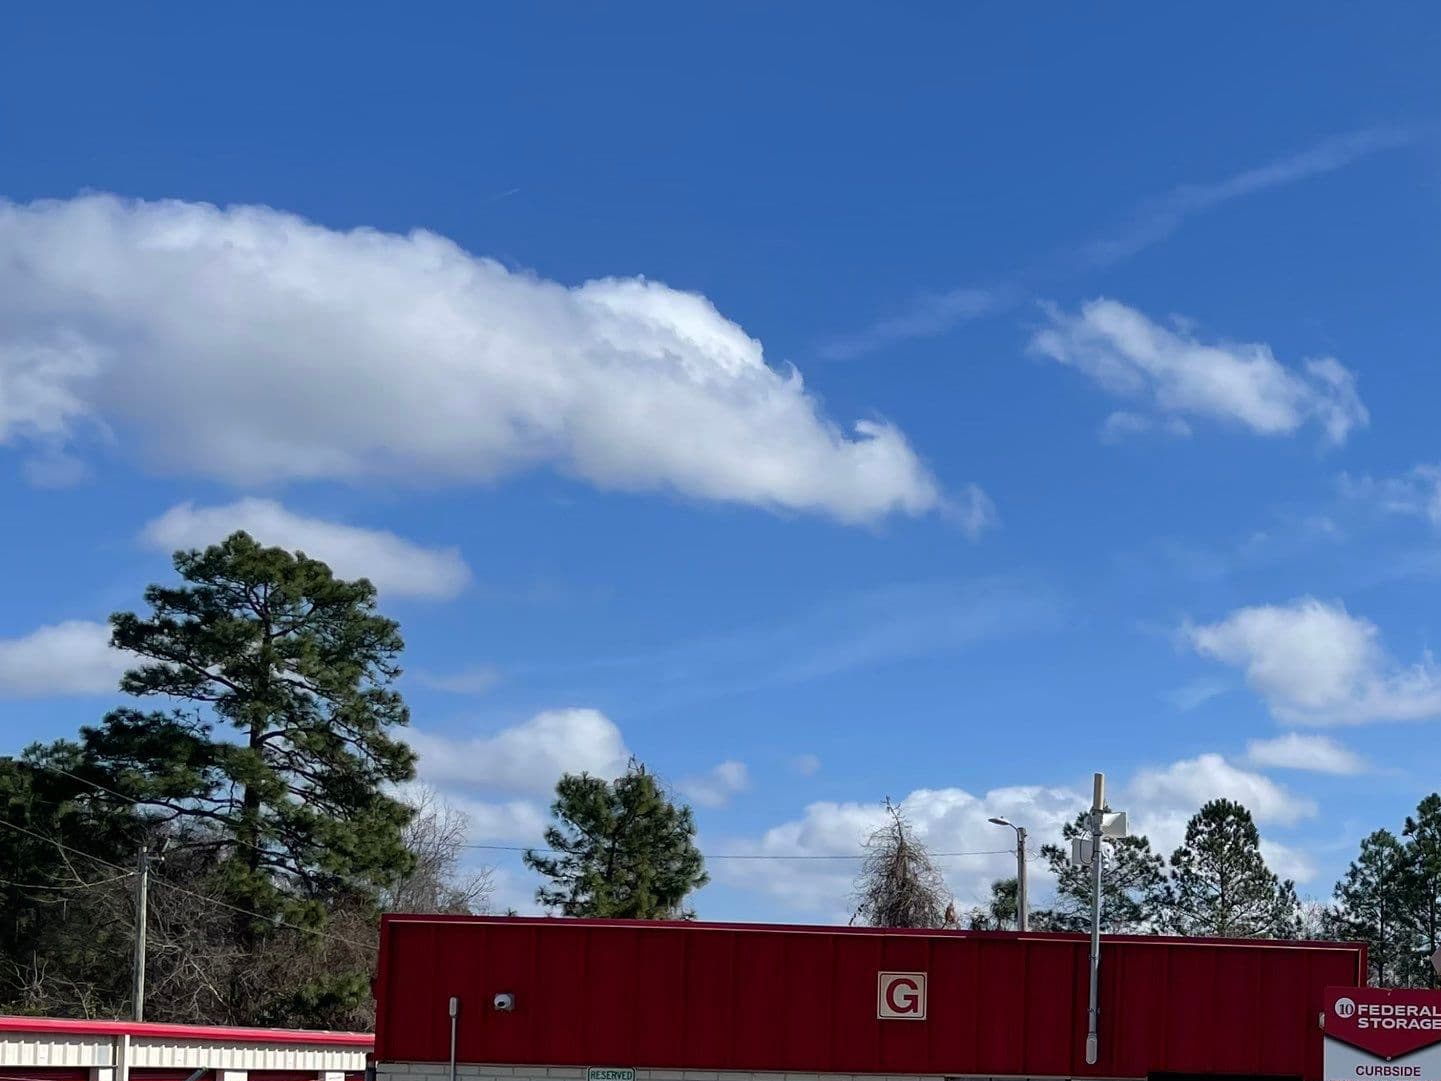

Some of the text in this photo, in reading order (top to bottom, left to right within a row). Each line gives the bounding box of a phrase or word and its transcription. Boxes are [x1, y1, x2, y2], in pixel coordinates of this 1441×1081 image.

[886, 978, 918, 1013] G
[1339, 1003, 1353, 1015] 10
[590, 1070, 632, 1080] RESERVED
[1355, 1065, 1421, 1077] CURBSIDE
